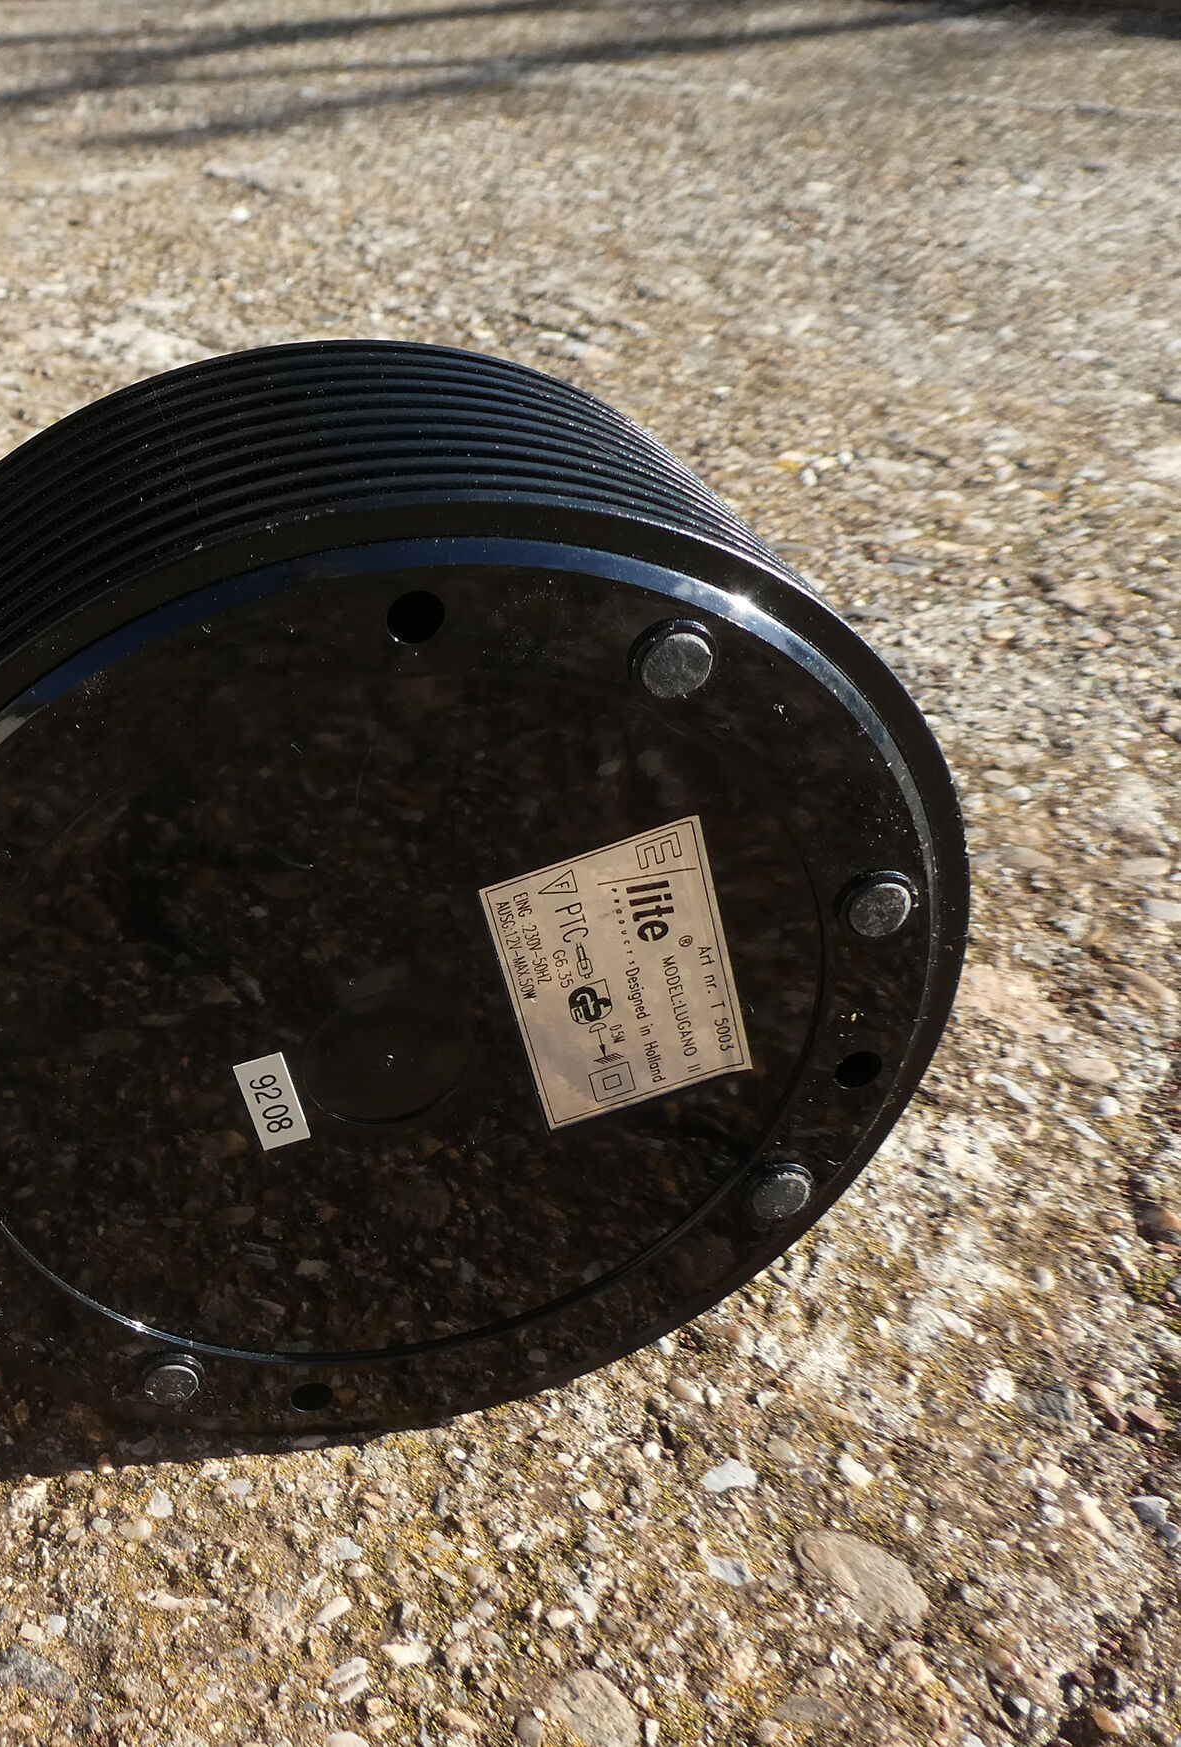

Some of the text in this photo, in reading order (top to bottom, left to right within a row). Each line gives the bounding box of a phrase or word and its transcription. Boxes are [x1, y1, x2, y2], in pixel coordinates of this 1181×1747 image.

[554, 901, 589, 944] PTC
[552, 949, 574, 989] G6.35
[697, 945, 716, 966] Art
[710, 1000, 725, 1009] T
[625, 966, 666, 1083] Designed in Holland
[713, 1017, 734, 1052] 5003
